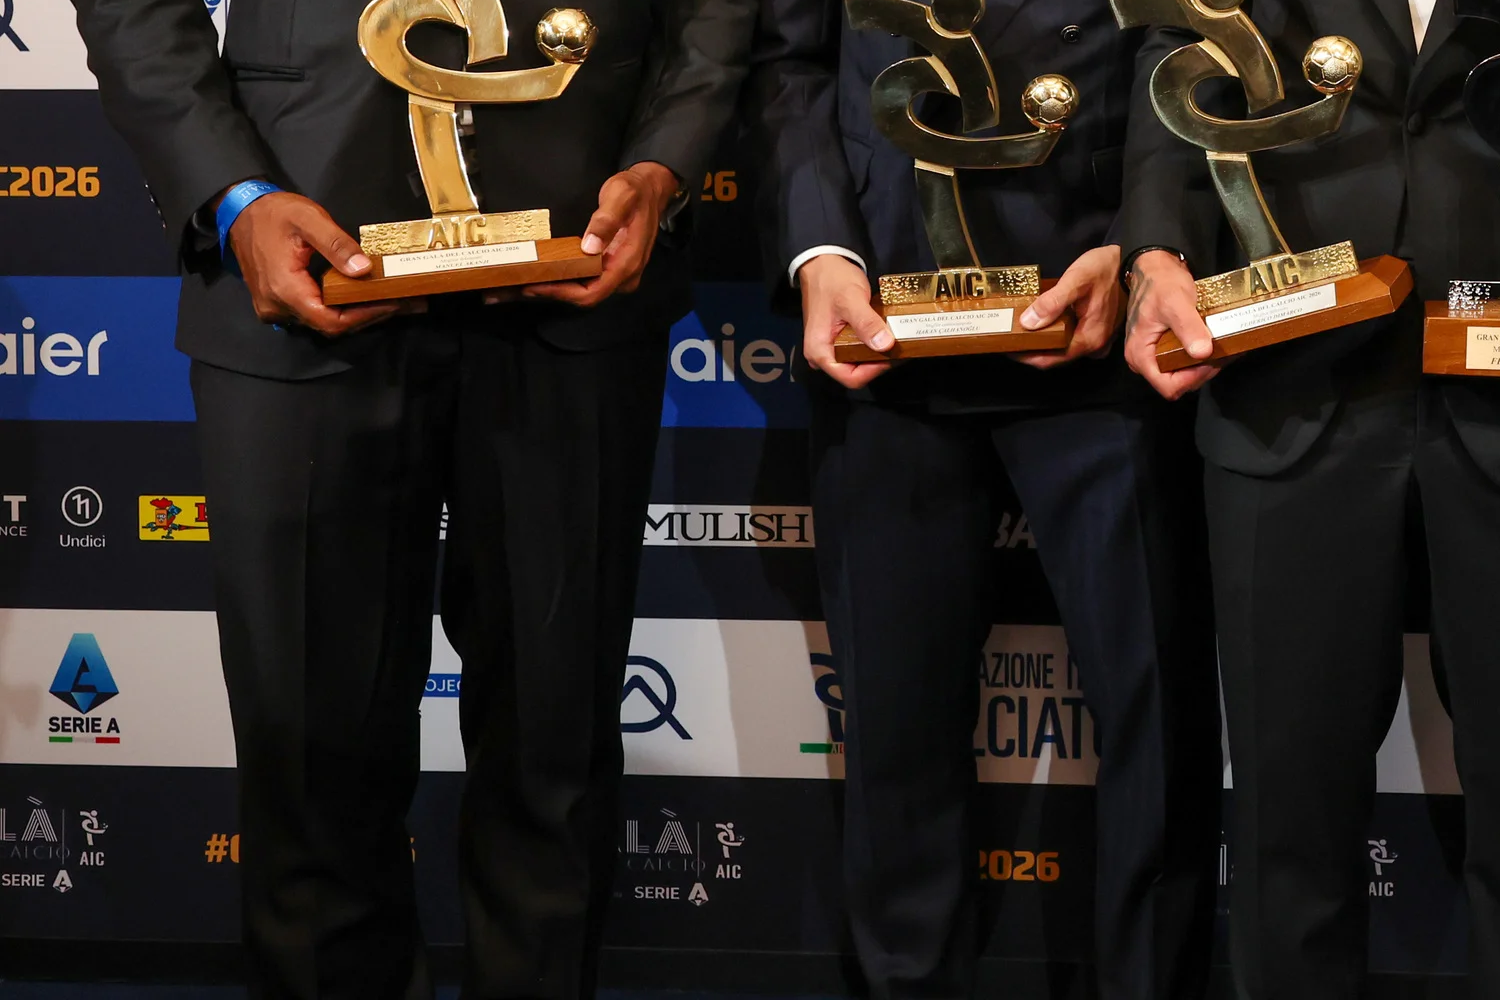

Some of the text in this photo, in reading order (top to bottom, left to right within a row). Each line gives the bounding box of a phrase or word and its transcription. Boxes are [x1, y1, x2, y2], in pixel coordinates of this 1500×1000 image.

[428, 215, 487, 250] AIC
[1250, 257, 1299, 296] AIC
[935, 272, 986, 301] AIC
[1476, 333, 1499, 341] GRAN
[0, 317, 108, 377] ier
[670, 323, 796, 383] aie
[59, 533, 106, 549] Undici
[48, 717, 120, 734] SERIE A
[79, 851, 105, 866] AIC
[715, 864, 742, 879] AIC
[1, 873, 46, 887] SERIE
[634, 885, 680, 900] SERIE
[1368, 881, 1394, 897] AIC
